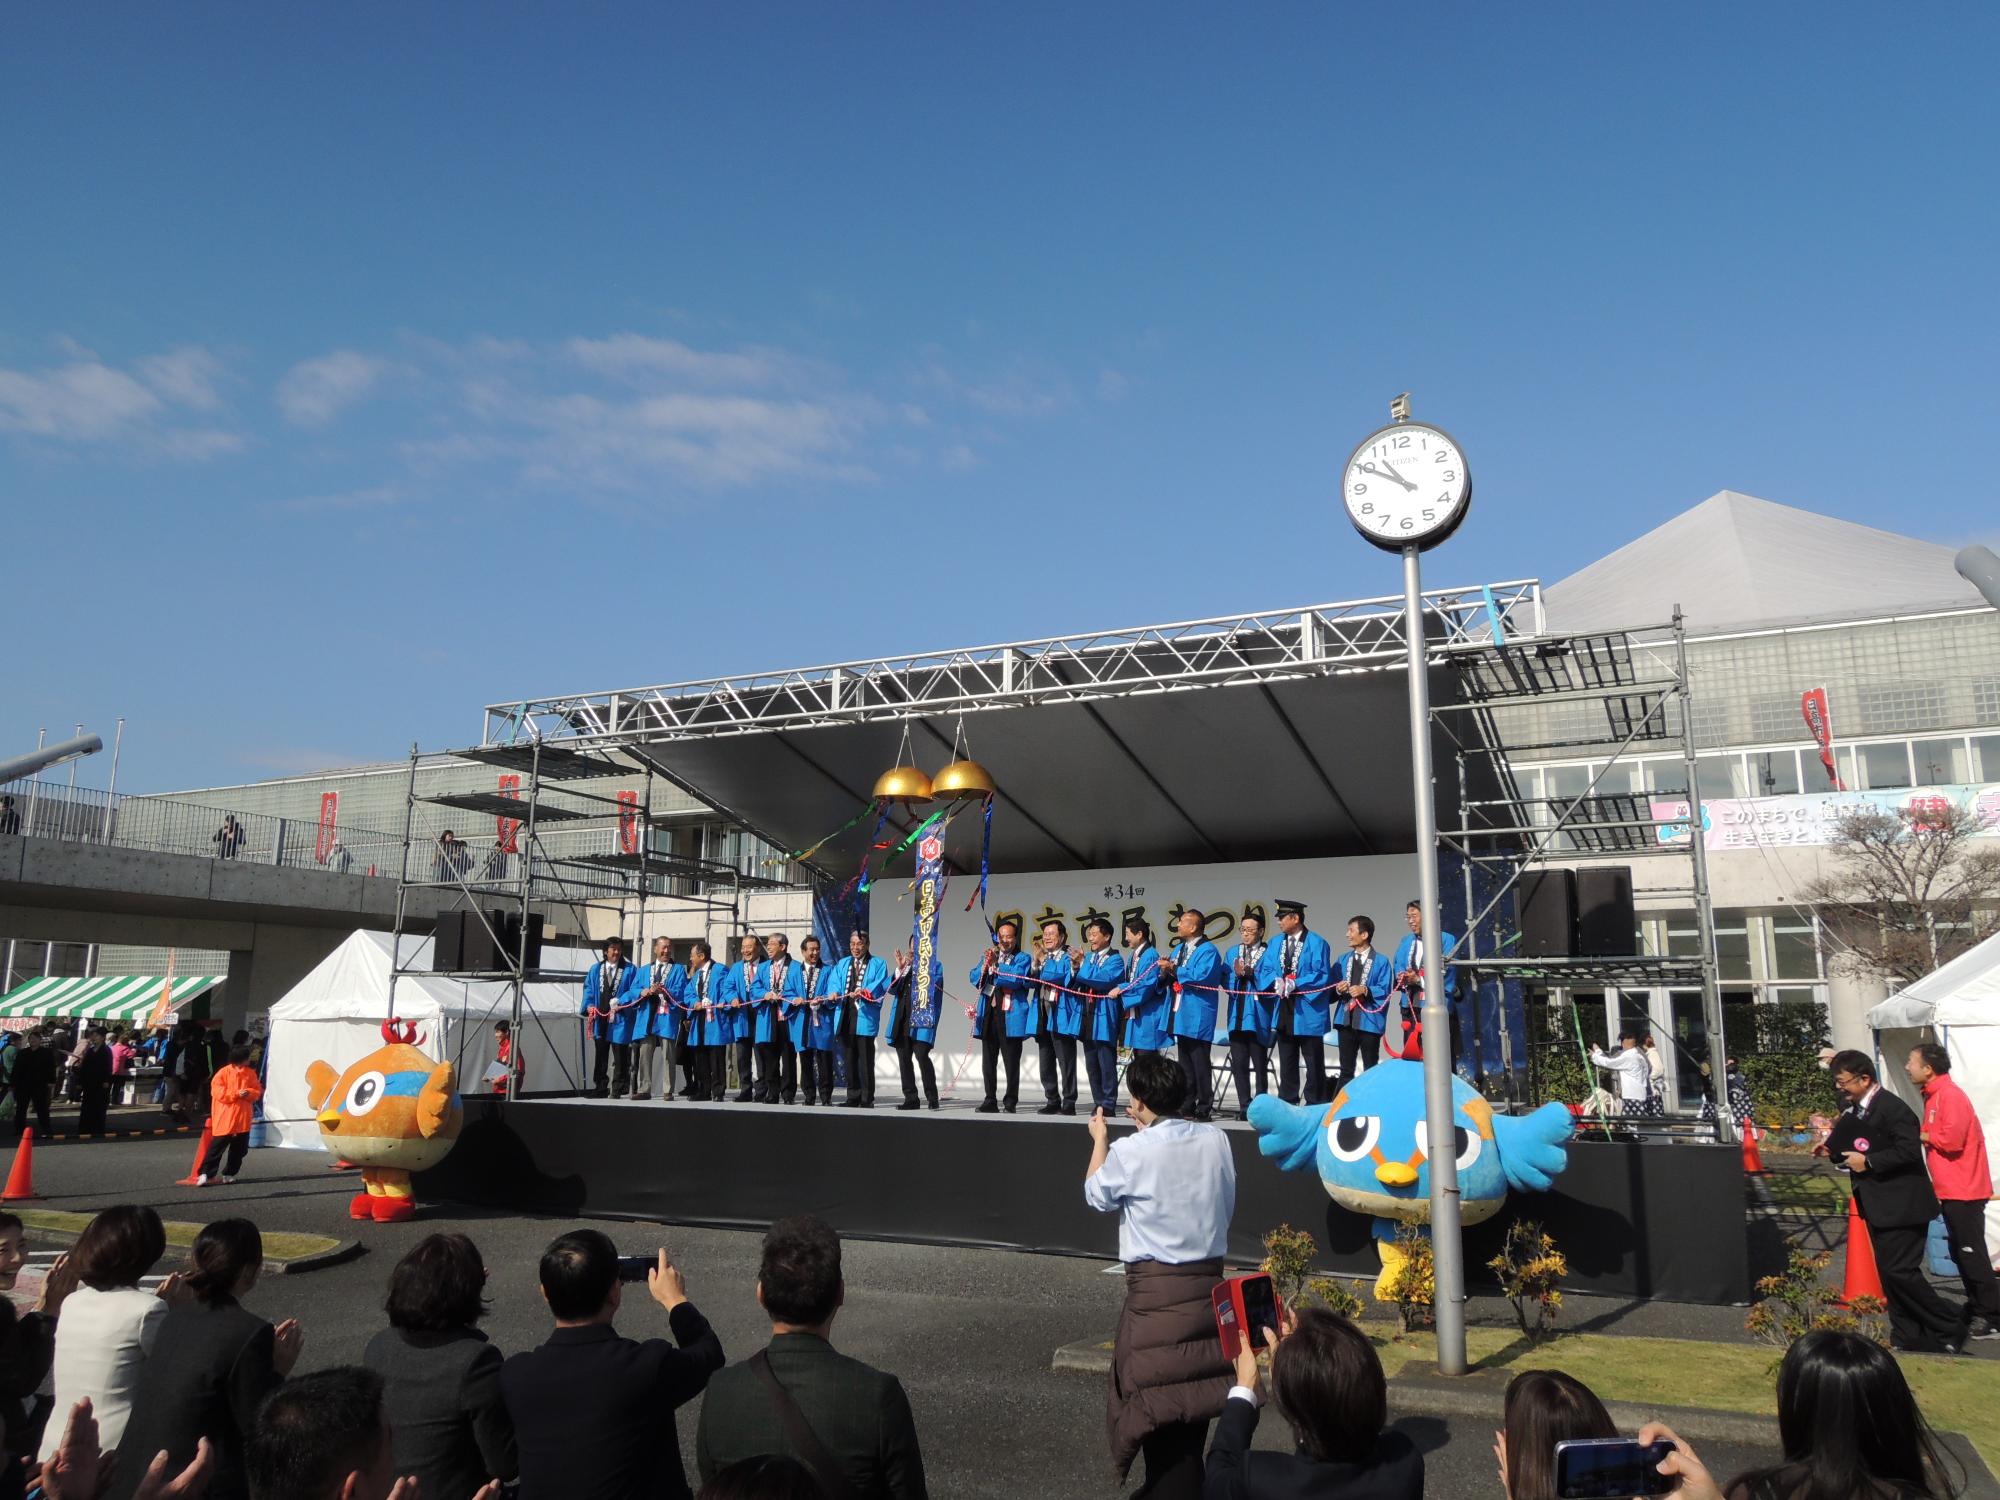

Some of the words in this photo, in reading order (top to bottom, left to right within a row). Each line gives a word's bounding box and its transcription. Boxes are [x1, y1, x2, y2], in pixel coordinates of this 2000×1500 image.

[1391, 435, 1411, 449] 12
[1372, 445, 1387, 458] 11
[1435, 451, 1448, 463] 2
[1357, 462, 1376, 474] 10
[1443, 470, 1455, 482] 3
[1354, 483, 1367, 495] 9
[1437, 491, 1451, 503] 4
[1361, 503, 1374, 514] 8
[1422, 508, 1435, 521] 5
[1378, 514, 1391, 527] 7
[1400, 517, 1414, 529] 6
[1103, 883, 1145, 900] 第34回
